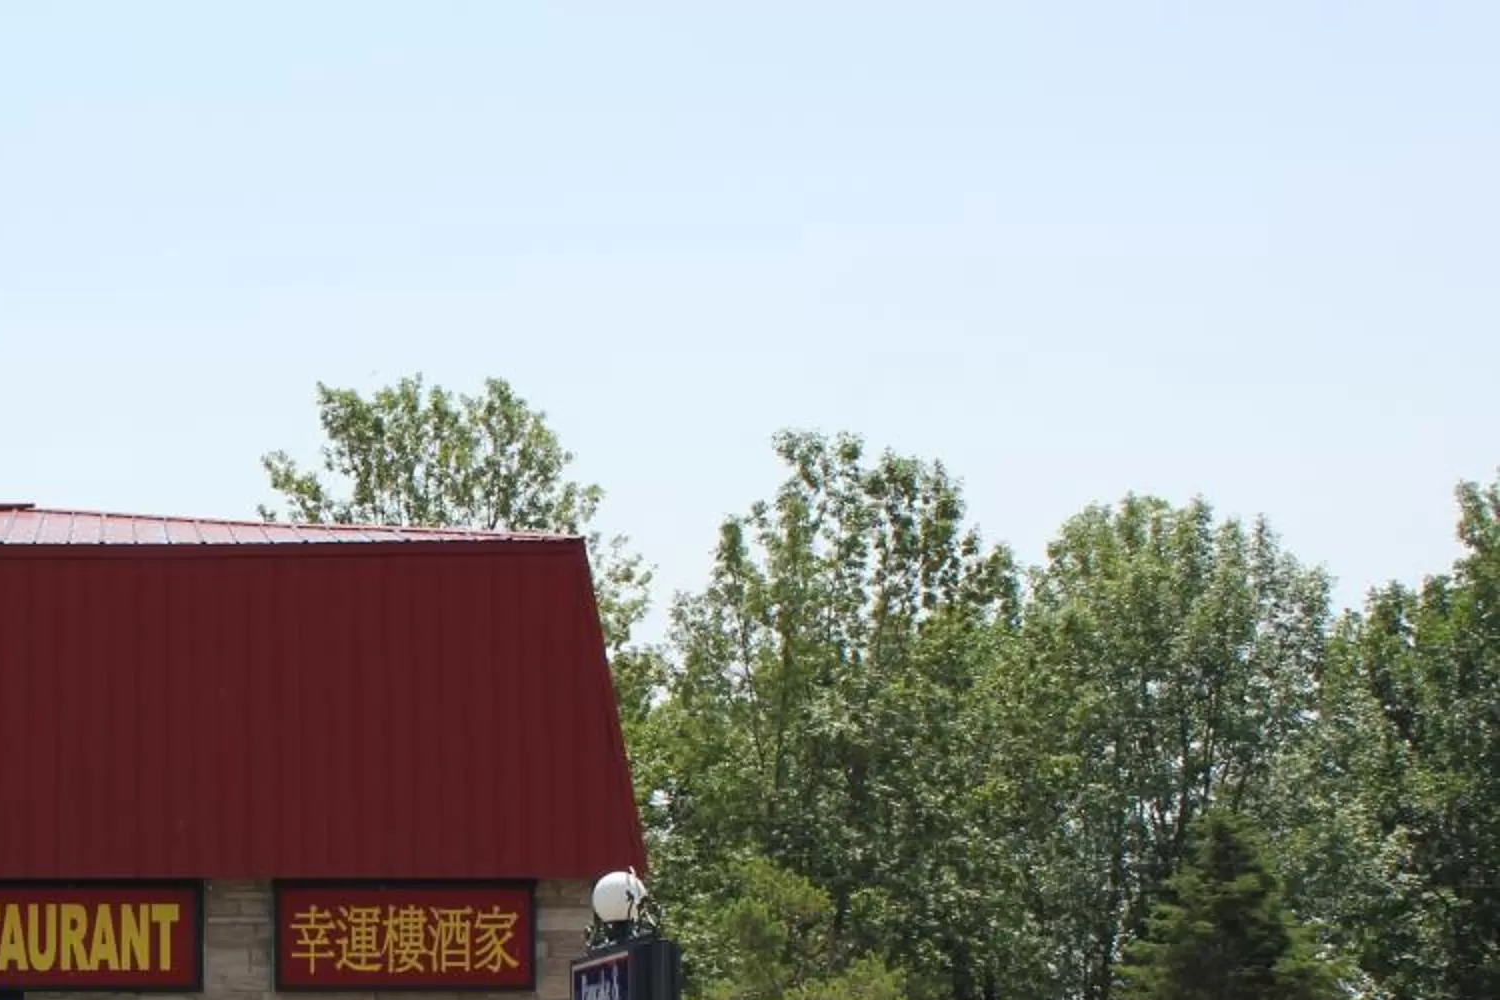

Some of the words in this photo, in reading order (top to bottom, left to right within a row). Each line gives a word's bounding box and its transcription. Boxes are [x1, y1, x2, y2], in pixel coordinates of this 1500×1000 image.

[290, 904, 520, 976] 幸運樓酒家
